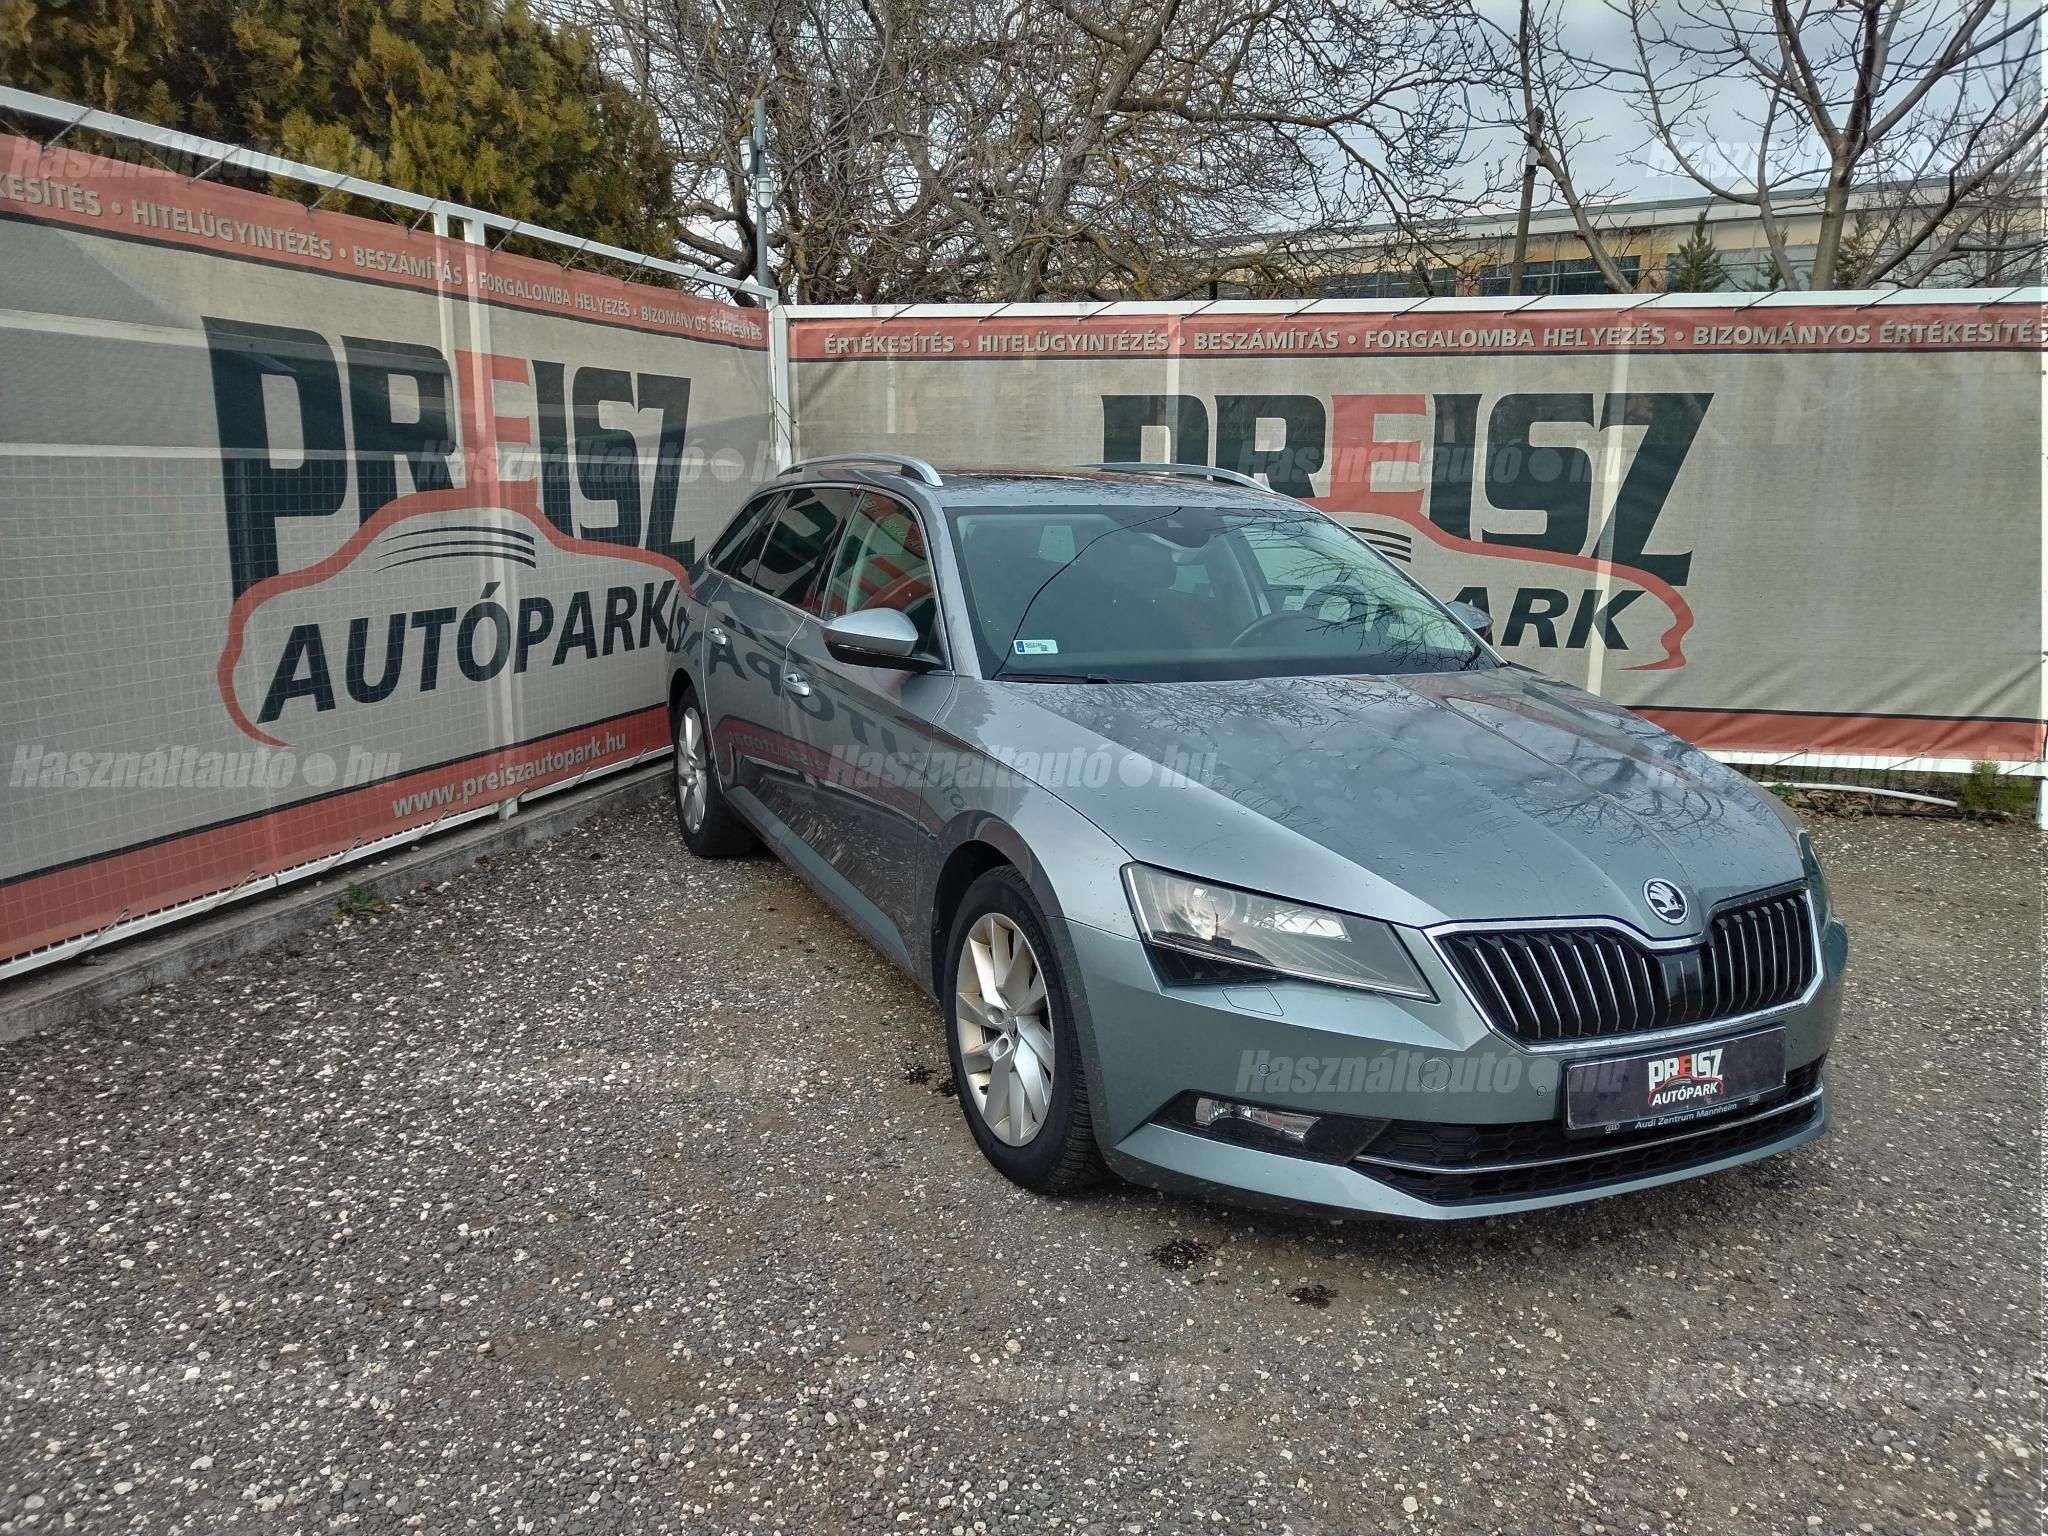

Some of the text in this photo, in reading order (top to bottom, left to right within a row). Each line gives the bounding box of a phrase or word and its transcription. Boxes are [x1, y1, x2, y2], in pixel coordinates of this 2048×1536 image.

[131, 199, 332, 260] HITELÜGYINTÉZÉS
[353, 245, 463, 285] BESZÁMÍTÁS
[479, 271, 572, 306] FORGALOMBA
[575, 293, 632, 317] HELYEZÉS
[824, 319, 2048, 354] ÉRTÉKESÍTÉS HITELÜGYINTÉZÉS BESZÁMÍTÁS FORGALOMBA HELYEZÉS BIZOMÁNYOS ÉRTÉKESÍTÉS
[201, 316, 695, 603] PREISZ
[256, 580, 677, 724] AUTÓPARK
[391, 731, 625, 818] www.preiszautopark.hu
[1648, 1048, 1723, 1092] PREISZ
[1651, 1081, 1719, 1106] AUTÓPARK
[1635, 1103, 1738, 1130] Audi Zentrum Mannheim
